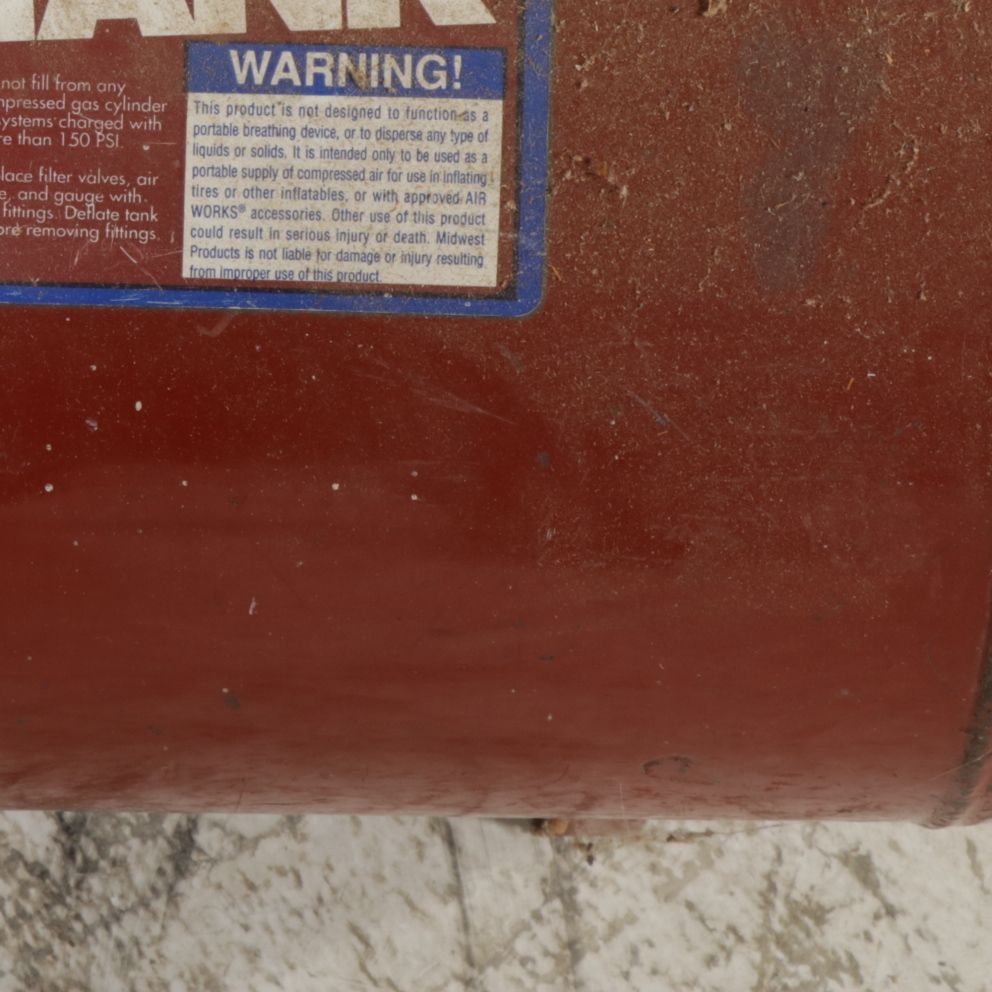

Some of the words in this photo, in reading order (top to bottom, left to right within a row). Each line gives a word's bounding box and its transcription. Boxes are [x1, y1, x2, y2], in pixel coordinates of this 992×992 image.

[229, 49, 462, 90] WARNING!
[2, 77, 25, 90] not
[32, 73, 49, 91] fill
[55, 74, 91, 92] from
[97, 82, 126, 96] any
[71, 99, 99, 115] gas
[105, 95, 167, 116] cylinder
[194, 101, 220, 115] This
[227, 102, 275, 117] product
[325, 105, 381, 122] designed
[406, 107, 456, 121] function
[59, 113, 124, 134] charged
[130, 115, 162, 131] with
[193, 124, 238, 138] portable
[243, 125, 296, 140] breathing
[301, 126, 339, 140] device,
[376, 127, 422, 142] disperse
[450, 129, 473, 144] type
[18, 129, 52, 146] than
[60, 132, 90, 147] 150
[193, 144, 229, 158] liquids
[251, 146, 287, 159] solids.
[320, 148, 367, 161] intended
[372, 149, 395, 164] only
[434, 151, 459, 163] used
[39, 166, 72, 184] filter
[79, 169, 130, 187] valves,
[136, 171, 158, 186] air
[192, 164, 237, 179] portable
[241, 167, 278, 180] supply
[297, 168, 365, 183] compressed
[443, 171, 487, 187] inflating
[18, 185, 48, 201] and
[54, 191, 104, 207] gauge
[110, 188, 142, 204] with
[191, 185, 218, 198] tires
[243, 186, 275, 199] other
[281, 187, 348, 202] inflatables,
[373, 190, 398, 203] with
[404, 191, 459, 205] approved
[3, 202, 58, 224] fittings.
[65, 205, 120, 221] Deflate
[125, 205, 158, 222] tank
[251, 209, 325, 222] accessories.
[332, 209, 364, 222] Other
[413, 211, 435, 225] this
[440, 212, 486, 226] product
[26, 224, 99, 243] removing
[106, 222, 160, 244] fittings.
[190, 226, 223, 239] could
[229, 226, 263, 240] result
[286, 229, 330, 241] serious
[336, 229, 369, 246] injury
[394, 230, 430, 244] death.
[436, 231, 485, 246] Midwest
[190, 245, 240, 259] Products
[282, 247, 311, 261] liable
[336, 248, 380, 264] damage
[401, 252, 432, 267] injury
[437, 253, 484, 267] resulting
[190, 265, 216, 278] from
[220, 267, 271, 280] improper
[313, 268, 333, 281] this
[337, 270, 382, 283] product.
